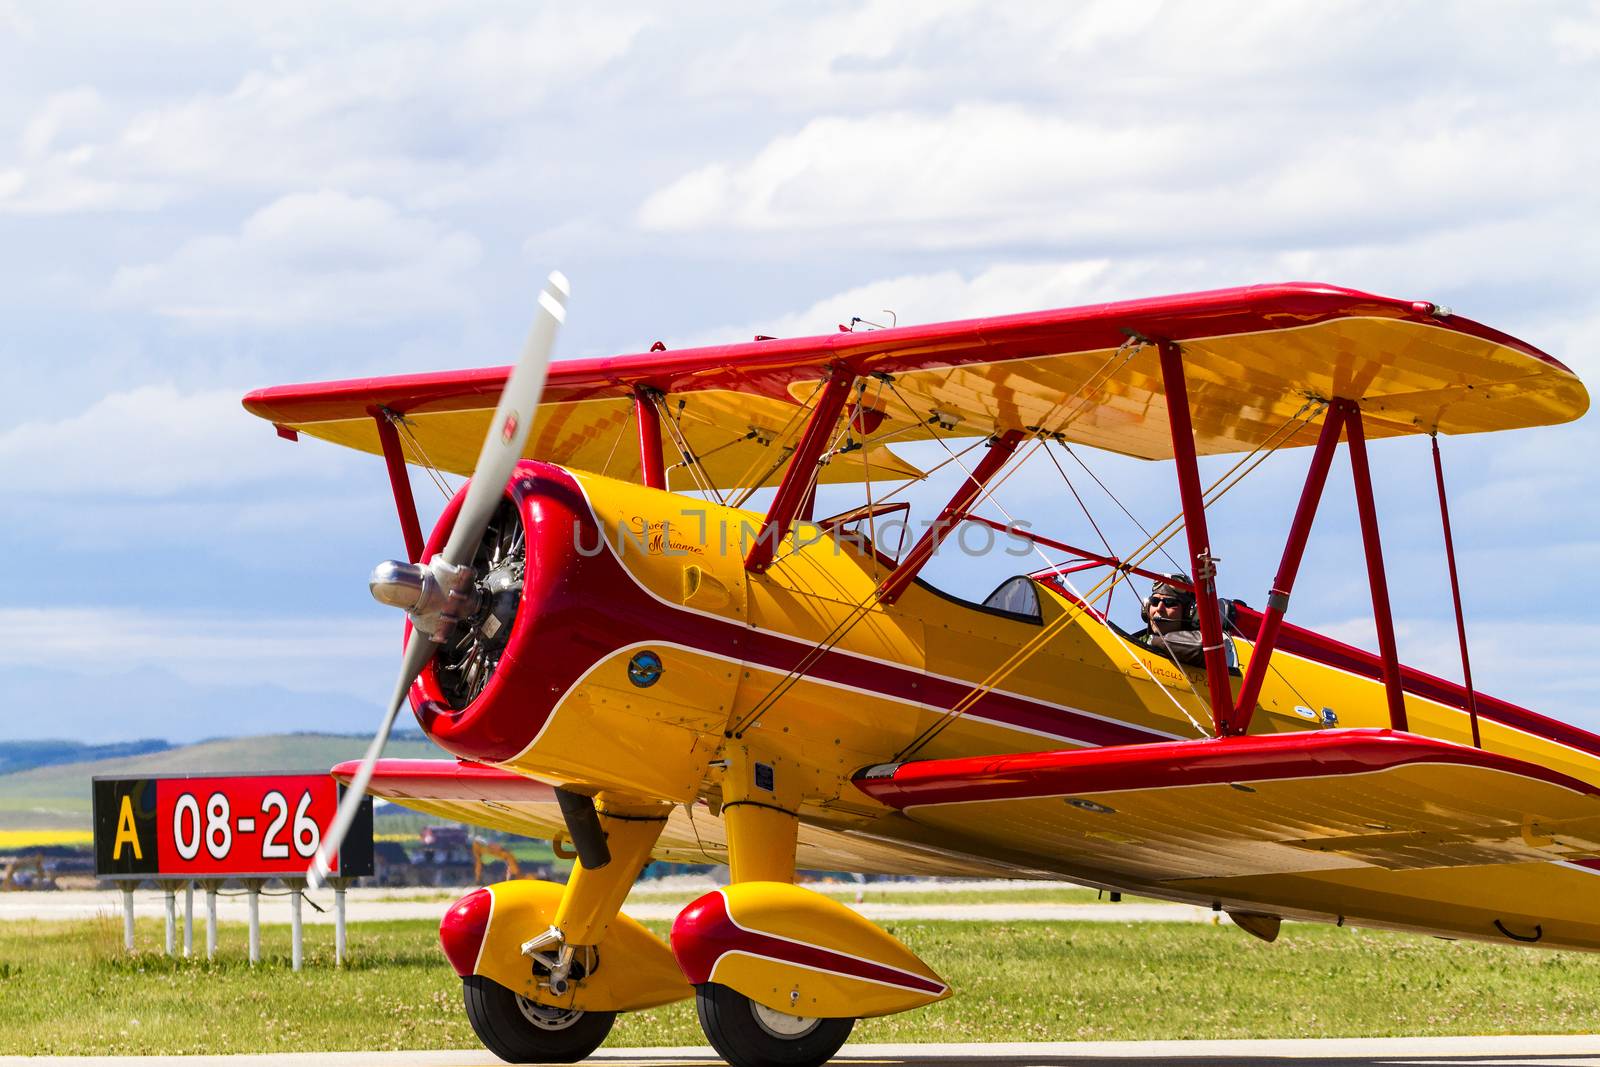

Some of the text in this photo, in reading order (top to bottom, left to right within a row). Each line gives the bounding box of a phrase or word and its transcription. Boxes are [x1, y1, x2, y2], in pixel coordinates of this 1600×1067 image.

[648, 534, 704, 556] Marianne
[1131, 658, 1183, 681] Marcus
[113, 789, 320, 861] A 08-26
